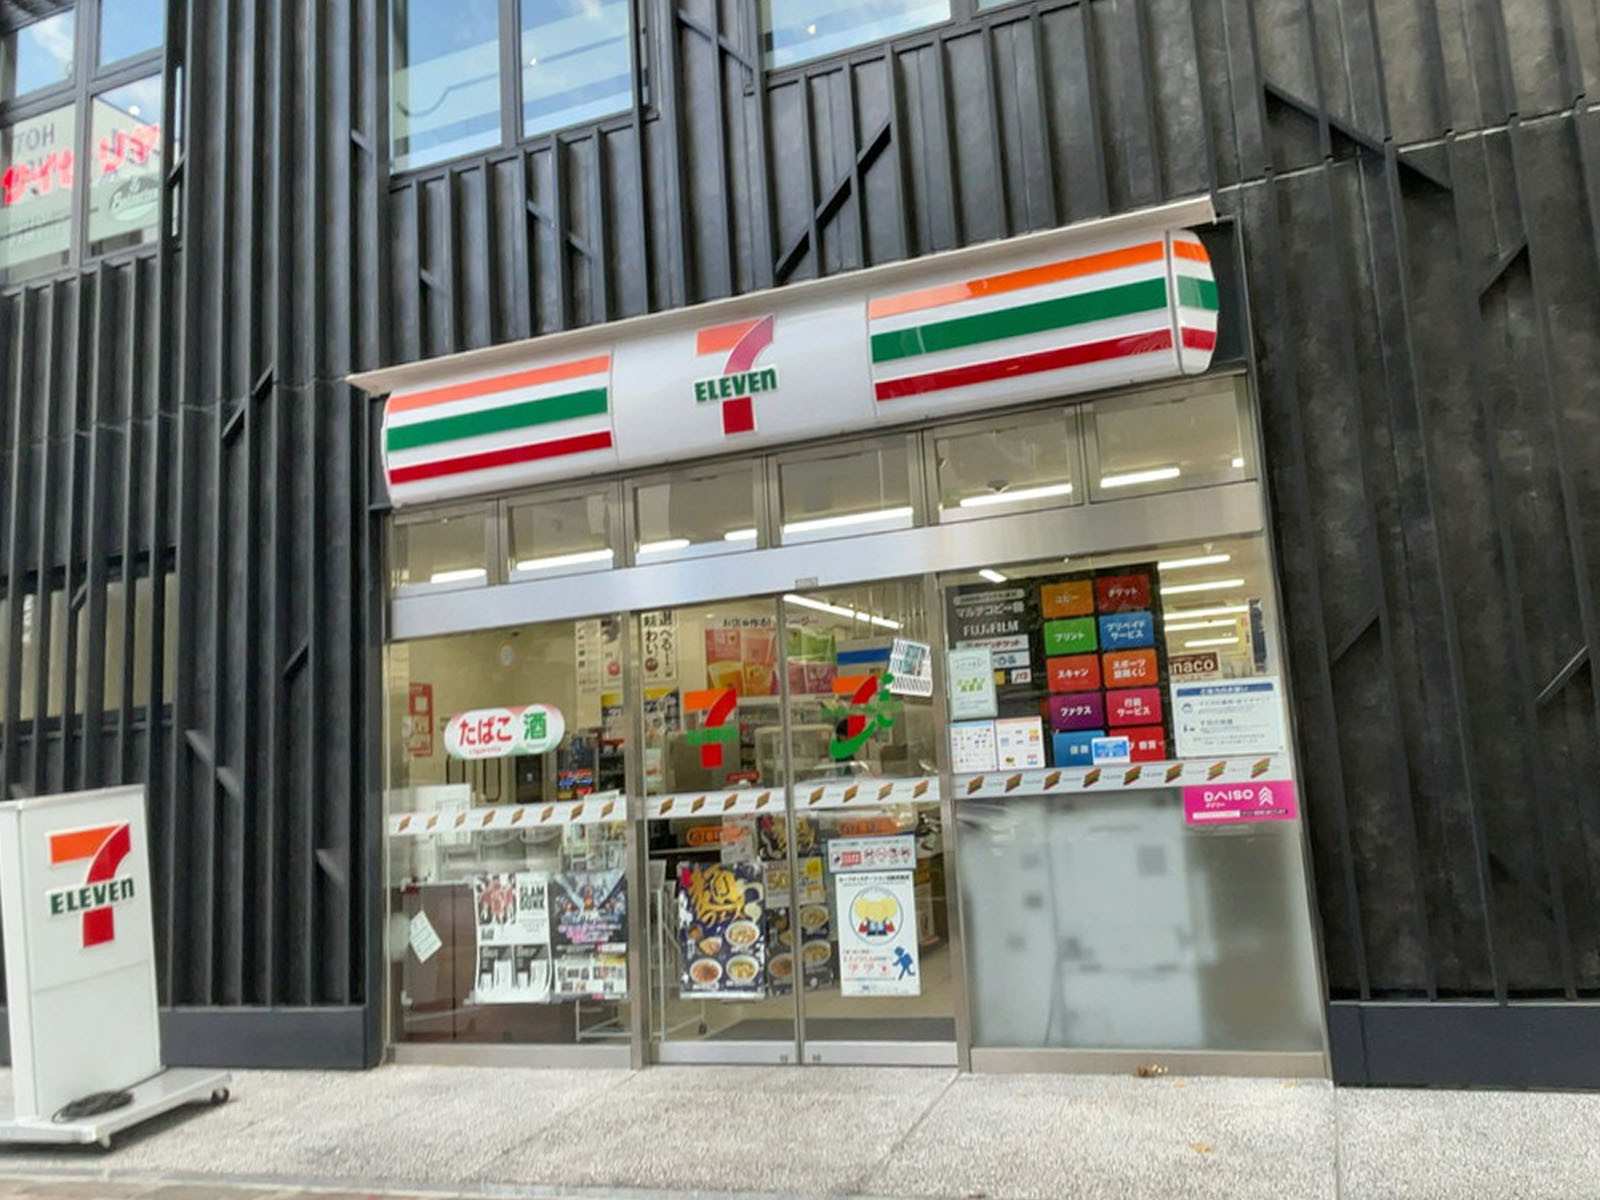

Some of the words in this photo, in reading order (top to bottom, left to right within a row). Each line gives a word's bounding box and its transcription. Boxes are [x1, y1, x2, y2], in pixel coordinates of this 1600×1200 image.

[696, 312, 774, 434] 7
[963, 620, 1019, 636] FUJIFILM
[1060, 706, 1092, 717] ファクス
[459, 716, 512, 746] たばこ
[524, 712, 547, 740] 酒
[1204, 789, 1254, 803] DAISO
[51, 823, 132, 948] 7
